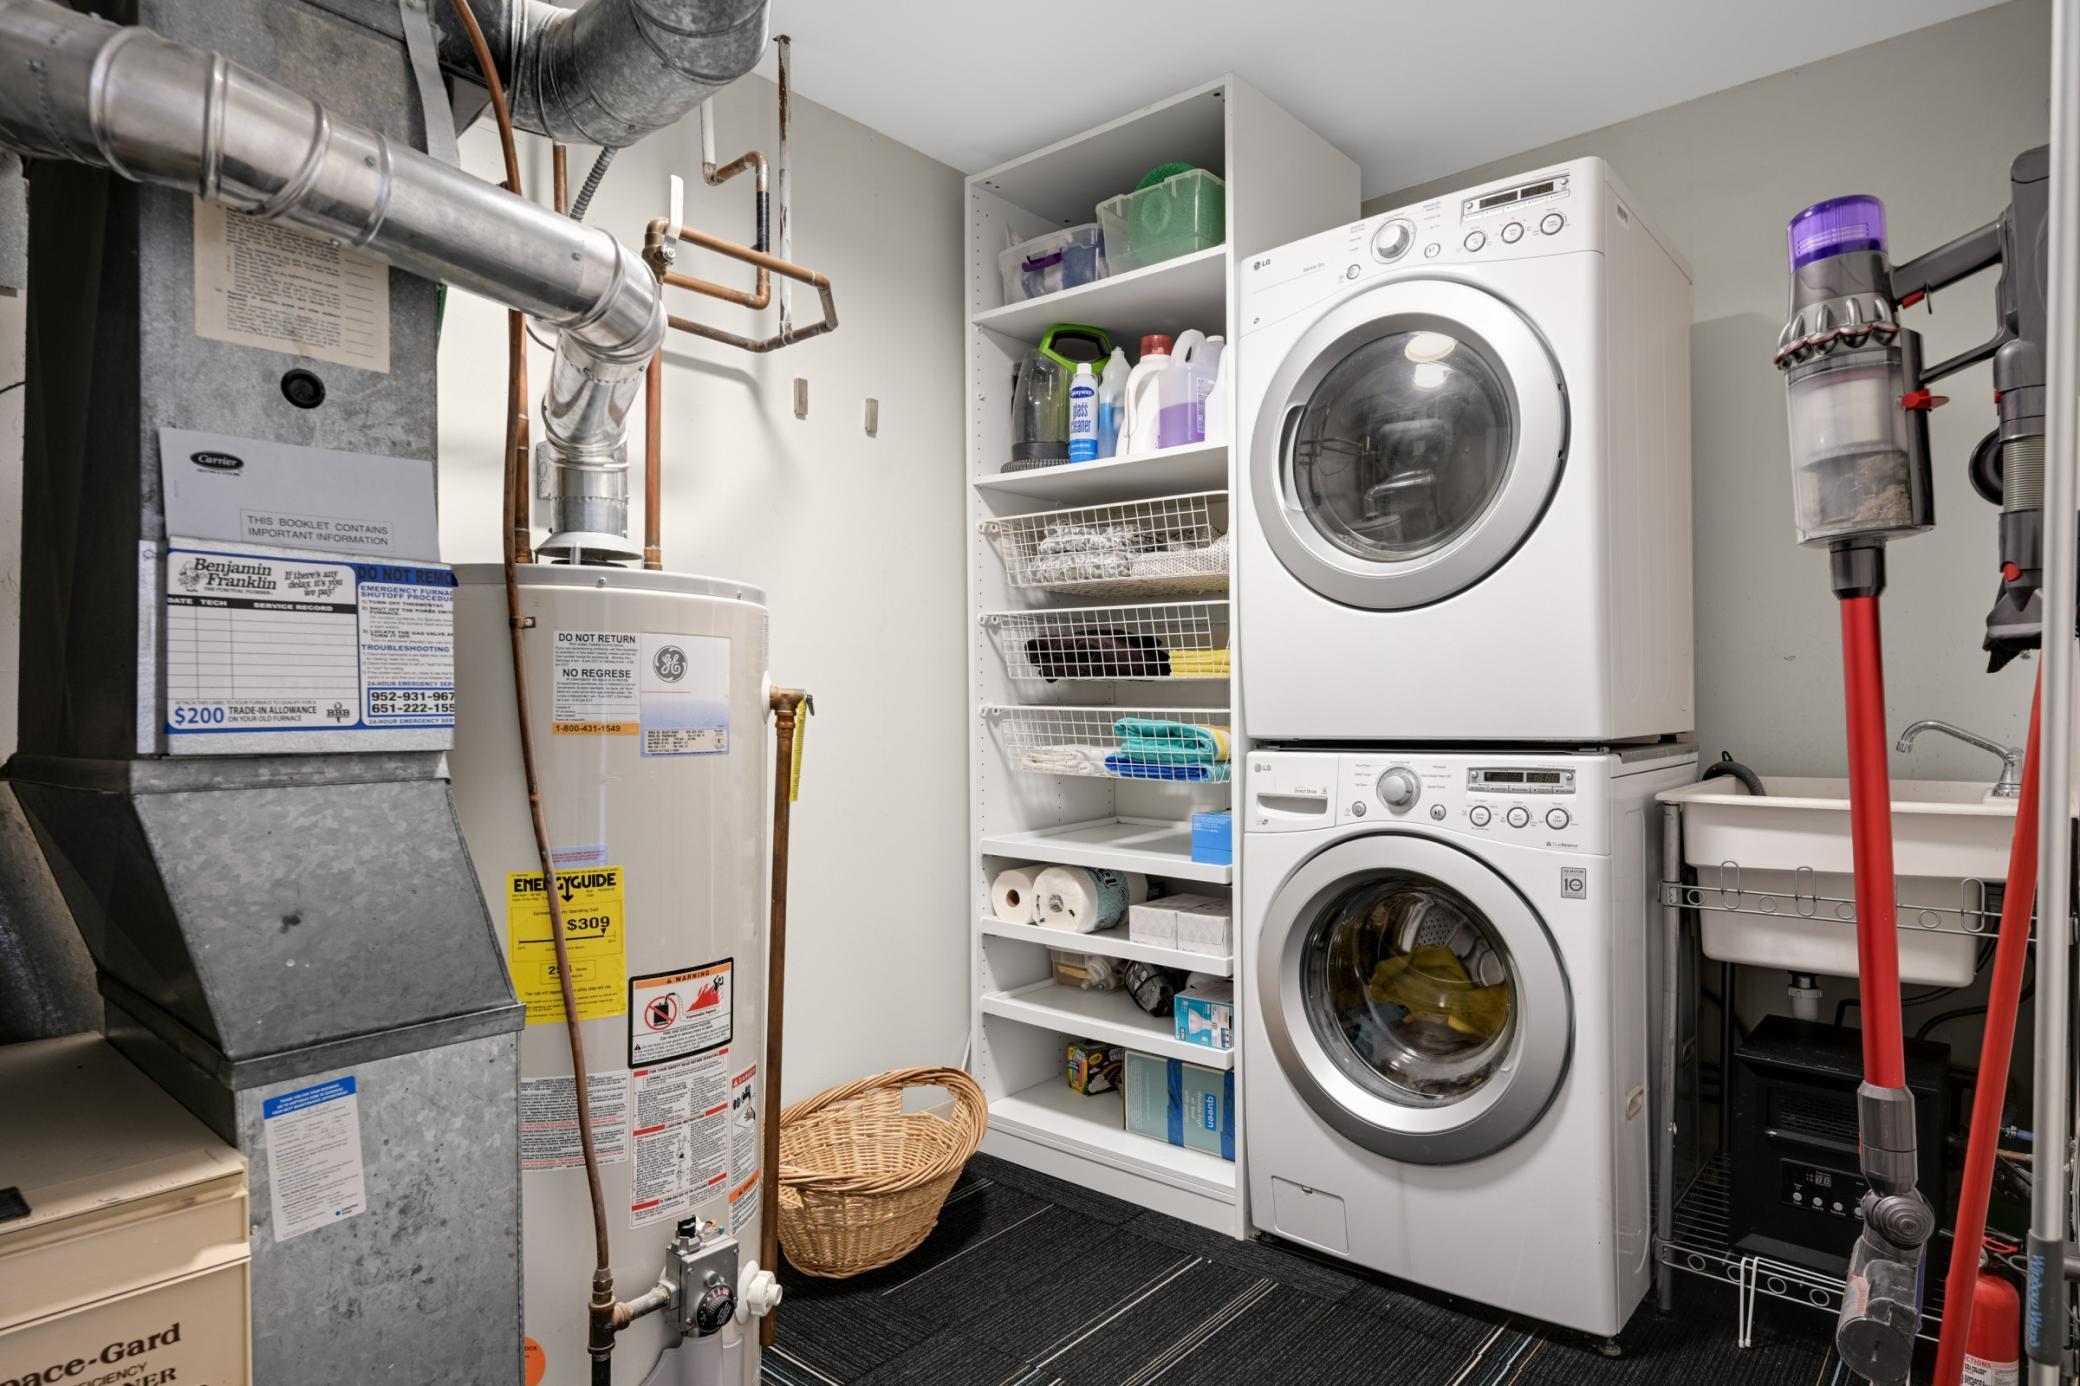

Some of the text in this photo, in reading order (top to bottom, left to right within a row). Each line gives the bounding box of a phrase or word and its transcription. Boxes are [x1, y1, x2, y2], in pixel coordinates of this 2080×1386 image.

[1072, 402, 1088, 419] glass
[198, 454, 238, 467] Carrier
[248, 516, 388, 534] THIS BOOKLET CONTAINS
[248, 528, 388, 546] IMPORTANT INFORMATION
[194, 558, 272, 576] Benjamin
[358, 566, 378, 579] DO
[383, 568, 410, 580] NOT
[206, 573, 277, 590] Franklin
[285, 570, 338, 580] If there's any
[328, 579, 343, 589] you
[360, 585, 418, 594] EMERGENCY
[304, 588, 316, 596] we
[168, 597, 194, 605] DATE
[254, 602, 294, 610] SERVICE
[558, 633, 635, 644] DO NOT RETURN
[360, 644, 450, 652] TROUBLESHOOTING
[563, 669, 631, 678] NO REGRESE
[175, 706, 224, 726] $200
[228, 705, 317, 714] TRADE-IN ALLOWANCE
[514, 872, 616, 892] ENEGYGUIDE
[567, 916, 610, 931] $309
[676, 970, 710, 981] WARNING
[1205, 1096, 1214, 1128] queen
[2030, 1255, 2044, 1310] Window
